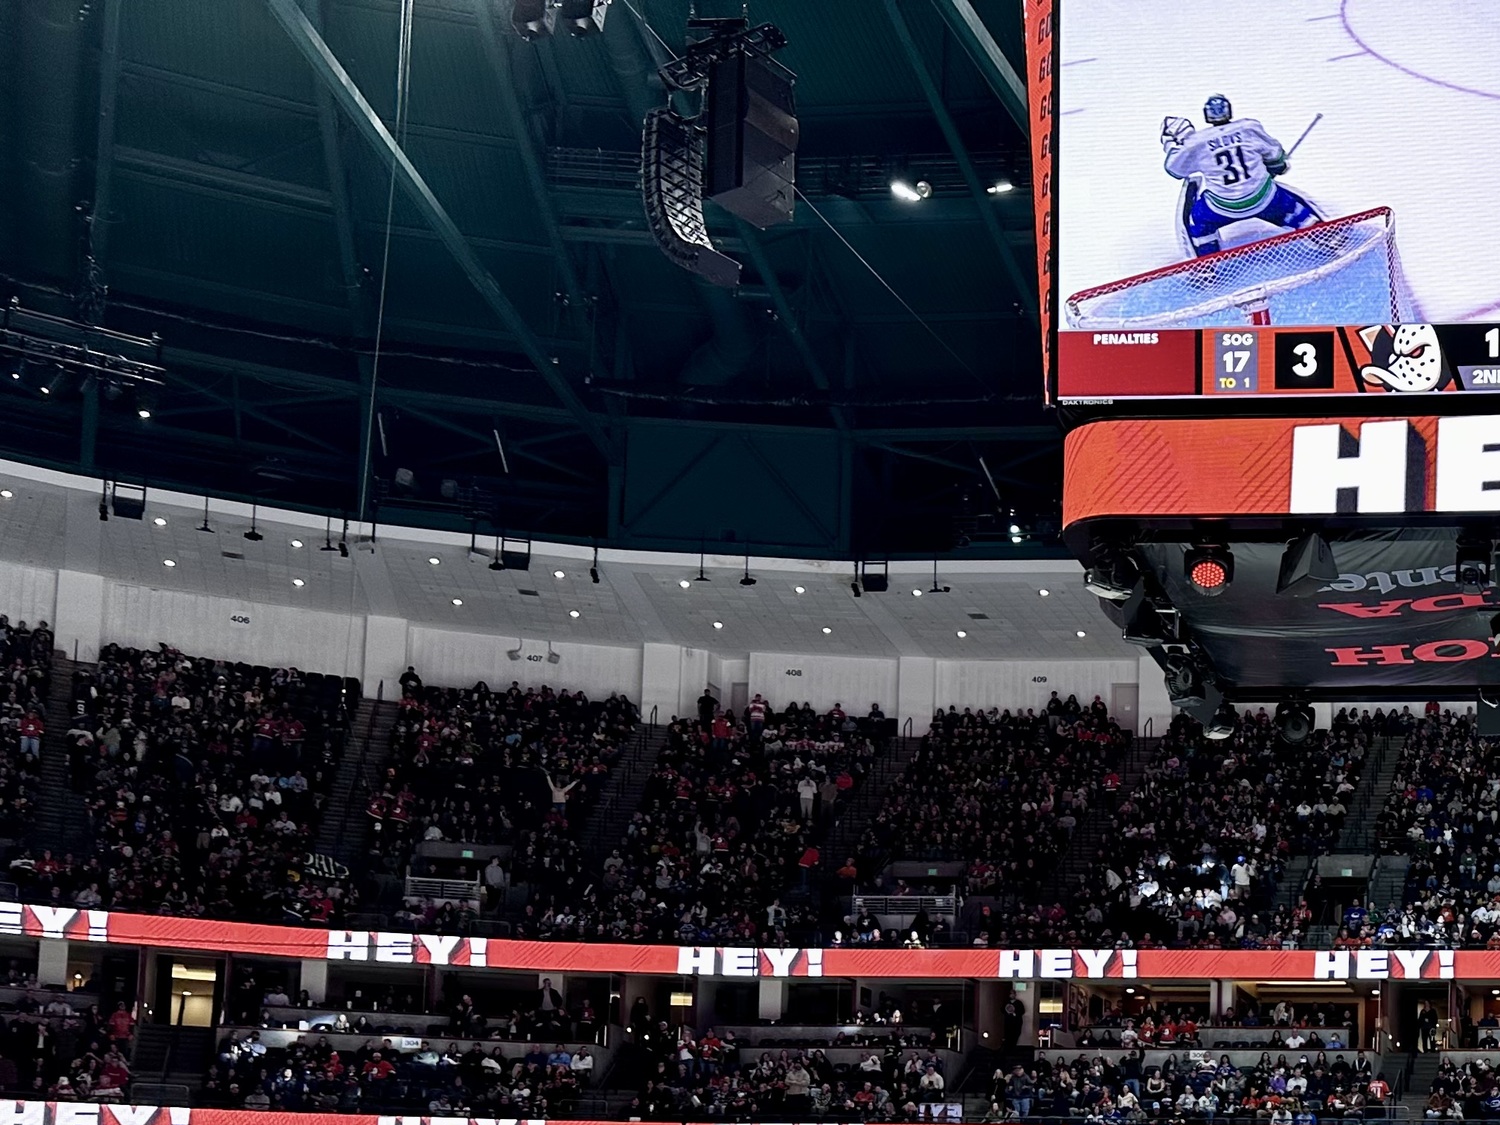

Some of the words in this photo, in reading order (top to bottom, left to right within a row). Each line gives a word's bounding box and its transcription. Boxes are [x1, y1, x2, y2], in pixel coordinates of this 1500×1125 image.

[1215, 146, 1251, 185] 31
[1093, 333, 1158, 346] PENALTIES
[1222, 333, 1253, 346] SOG
[1222, 351, 1250, 373] 17
[1292, 342, 1317, 377] 3
[1220, 377, 1236, 388] TO
[1244, 377, 1251, 388] 1
[1317, 563, 1496, 594] ente
[230, 615, 250, 624] 406
[526, 654, 543, 662] 407
[785, 669, 802, 677] 408
[327, 930, 488, 967] HEY!
[677, 946, 823, 977] HEY!
[999, 949, 1138, 978] HEY!
[1314, 949, 1455, 979] HEY!
